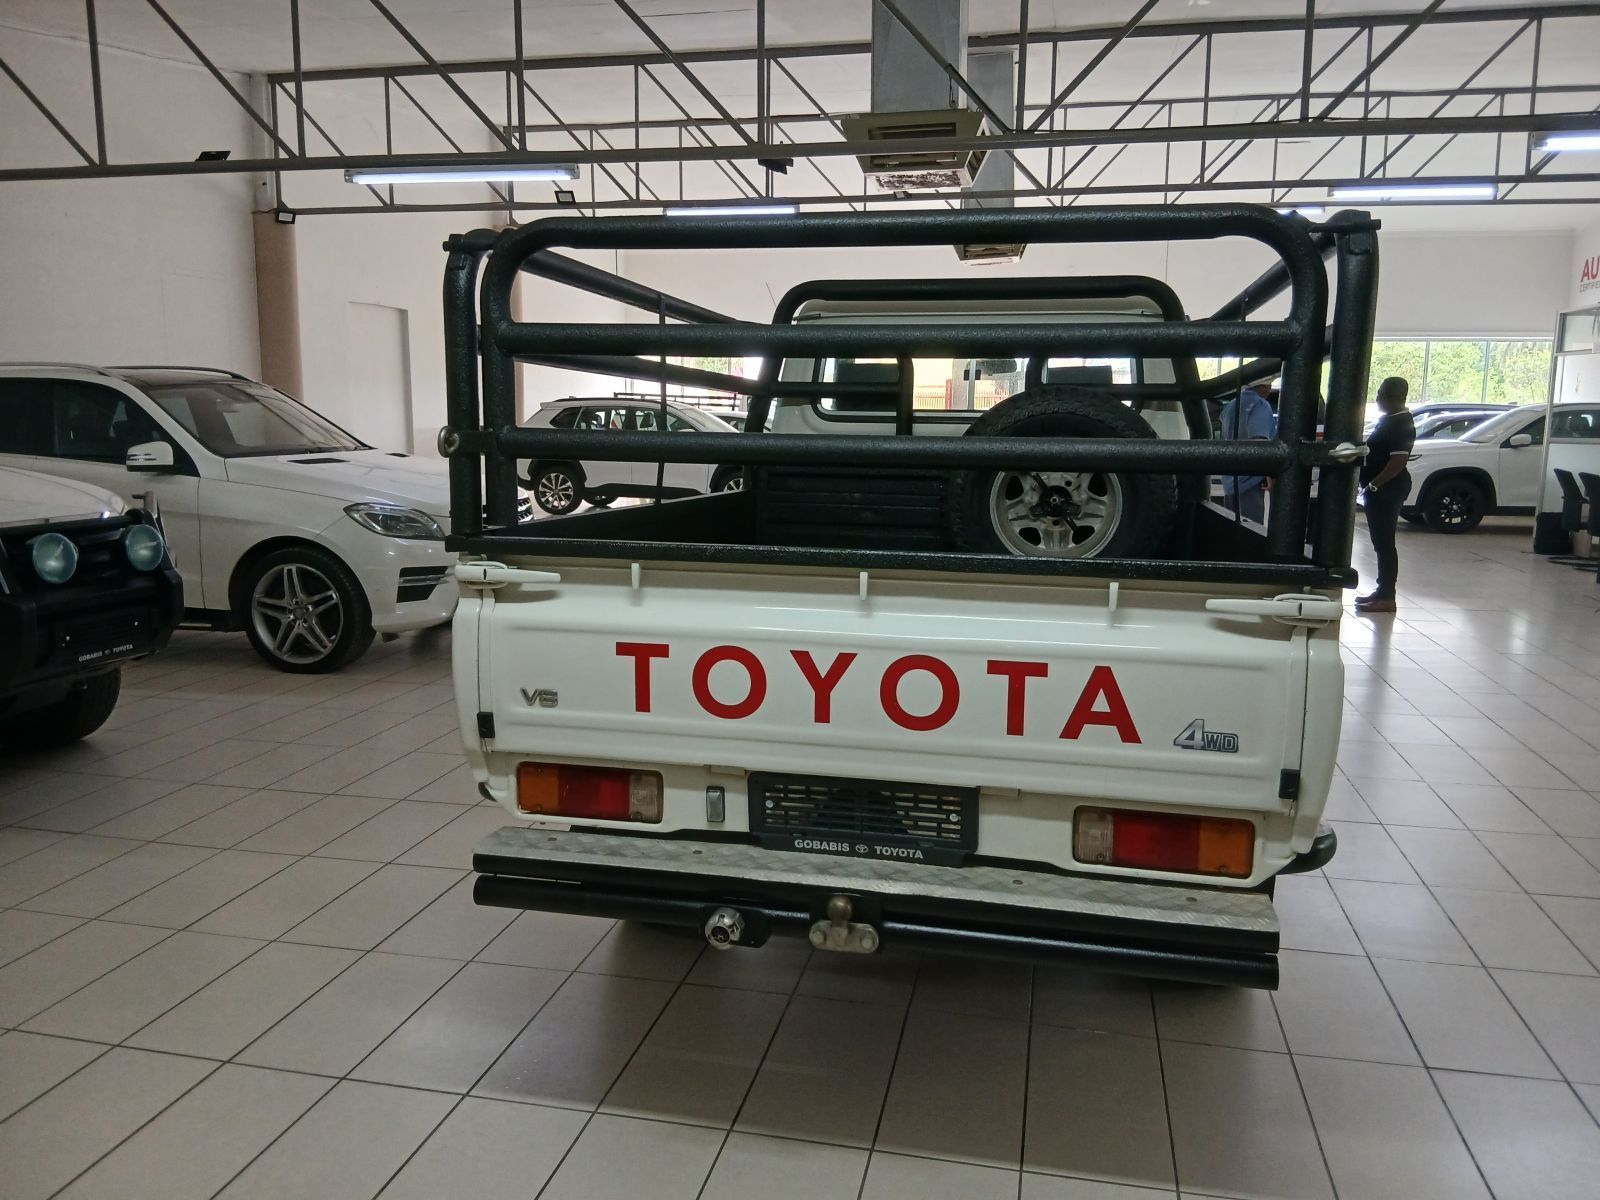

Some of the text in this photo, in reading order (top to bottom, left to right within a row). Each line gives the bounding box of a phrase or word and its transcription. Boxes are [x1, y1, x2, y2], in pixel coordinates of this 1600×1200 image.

[112, 644, 134, 653] TOYOTA
[615, 641, 1143, 744] TOYOTA
[1173, 718, 1239, 754] 4WD
[794, 838, 924, 860] GOBABIS TOYOTA
